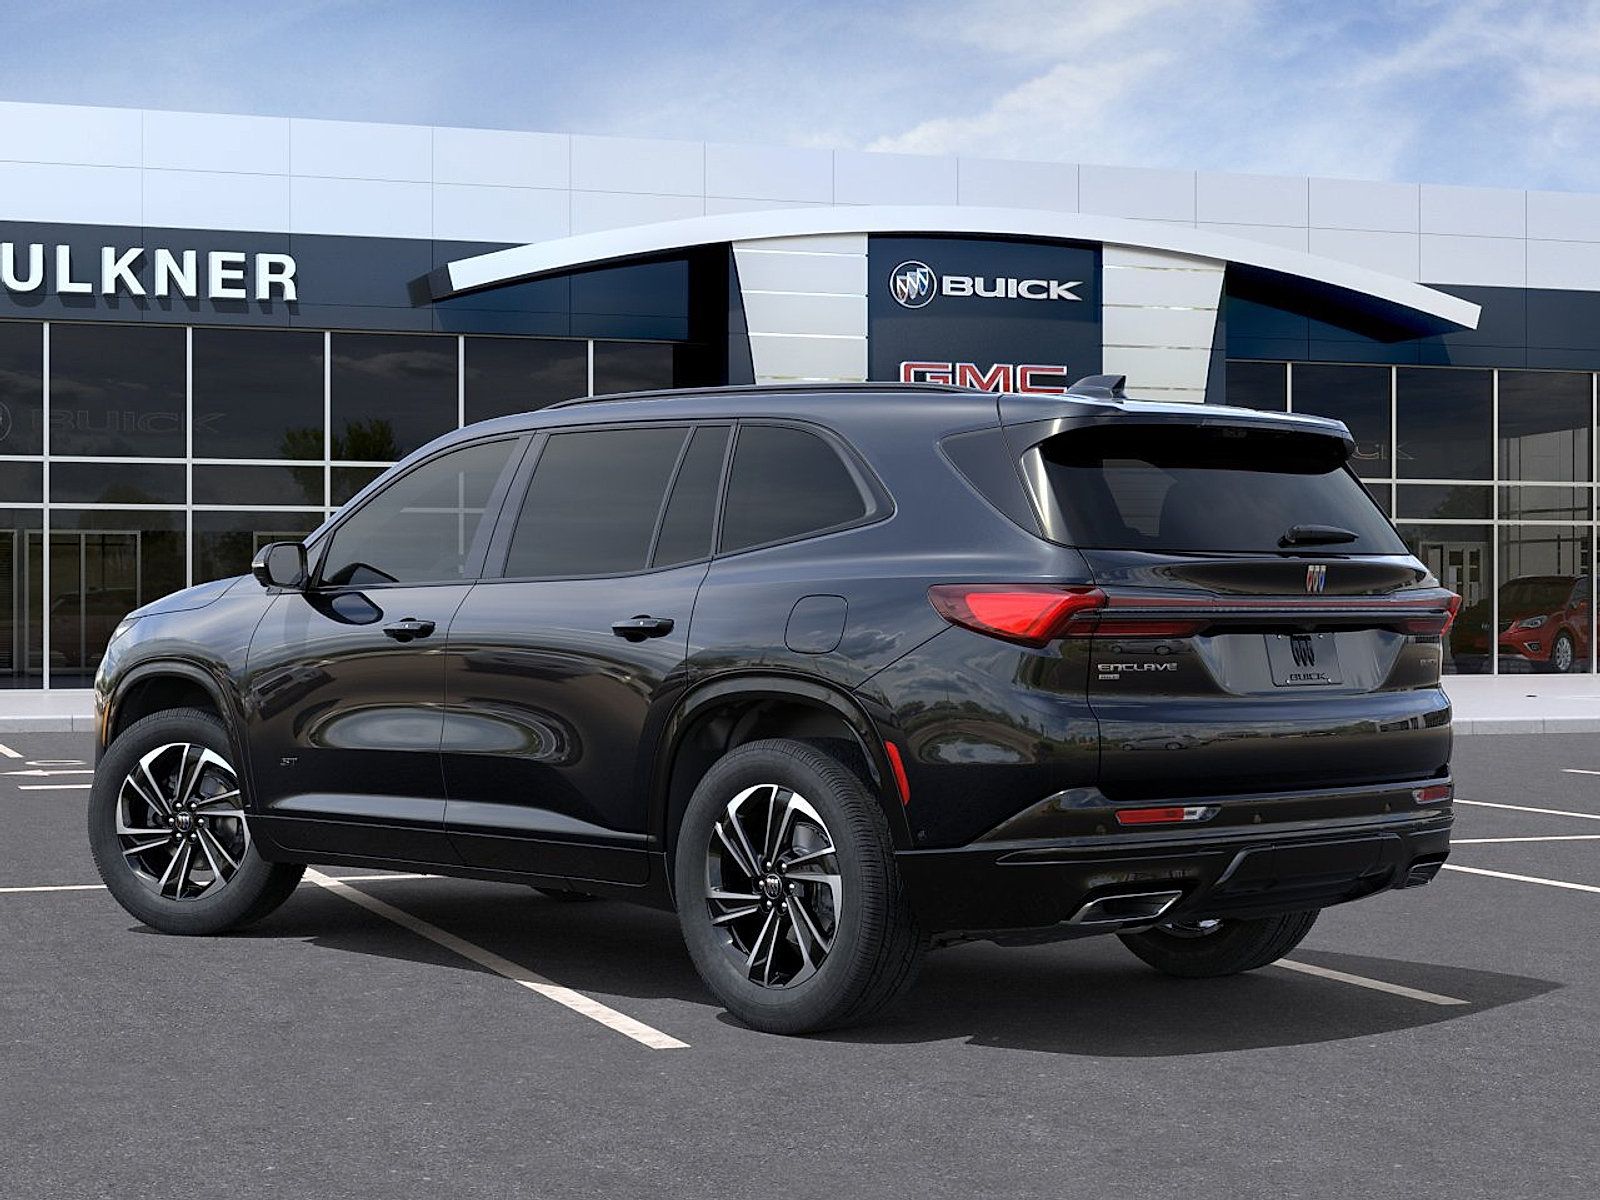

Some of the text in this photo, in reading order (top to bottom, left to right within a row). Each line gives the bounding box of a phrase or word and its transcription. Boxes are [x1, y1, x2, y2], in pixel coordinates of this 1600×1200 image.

[942, 275, 1084, 301] BUICK
[900, 361, 1068, 393] GMC
[1097, 662, 1178, 672] ENCLAVE
[1290, 672, 1326, 681] BUICK
